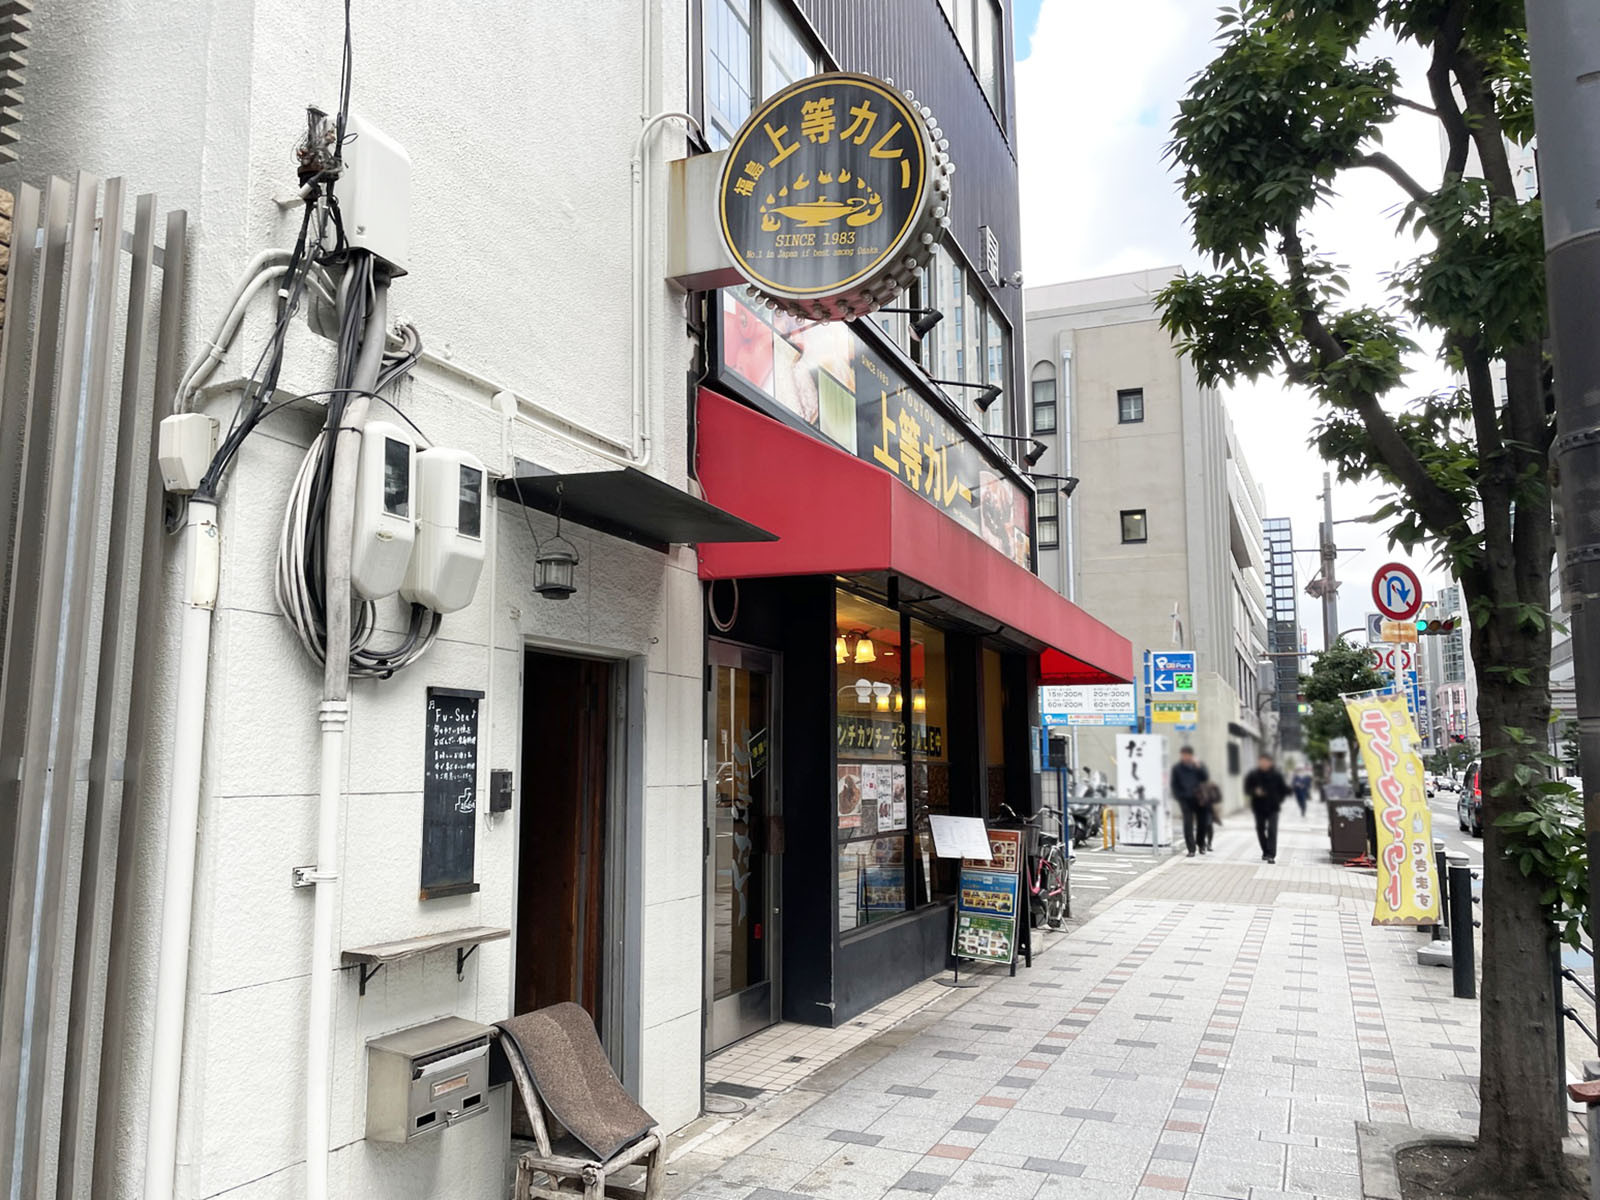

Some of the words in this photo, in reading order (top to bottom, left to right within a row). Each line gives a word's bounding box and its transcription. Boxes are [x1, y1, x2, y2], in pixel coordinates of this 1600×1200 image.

[733, 160, 766, 197] 福島
[763, 97, 911, 190] 上等カレー
[775, 233, 816, 247] SINCE
[823, 231, 856, 246] 1983
[777, 249, 799, 259] Japan
[873, 390, 972, 507] 上等カレー
